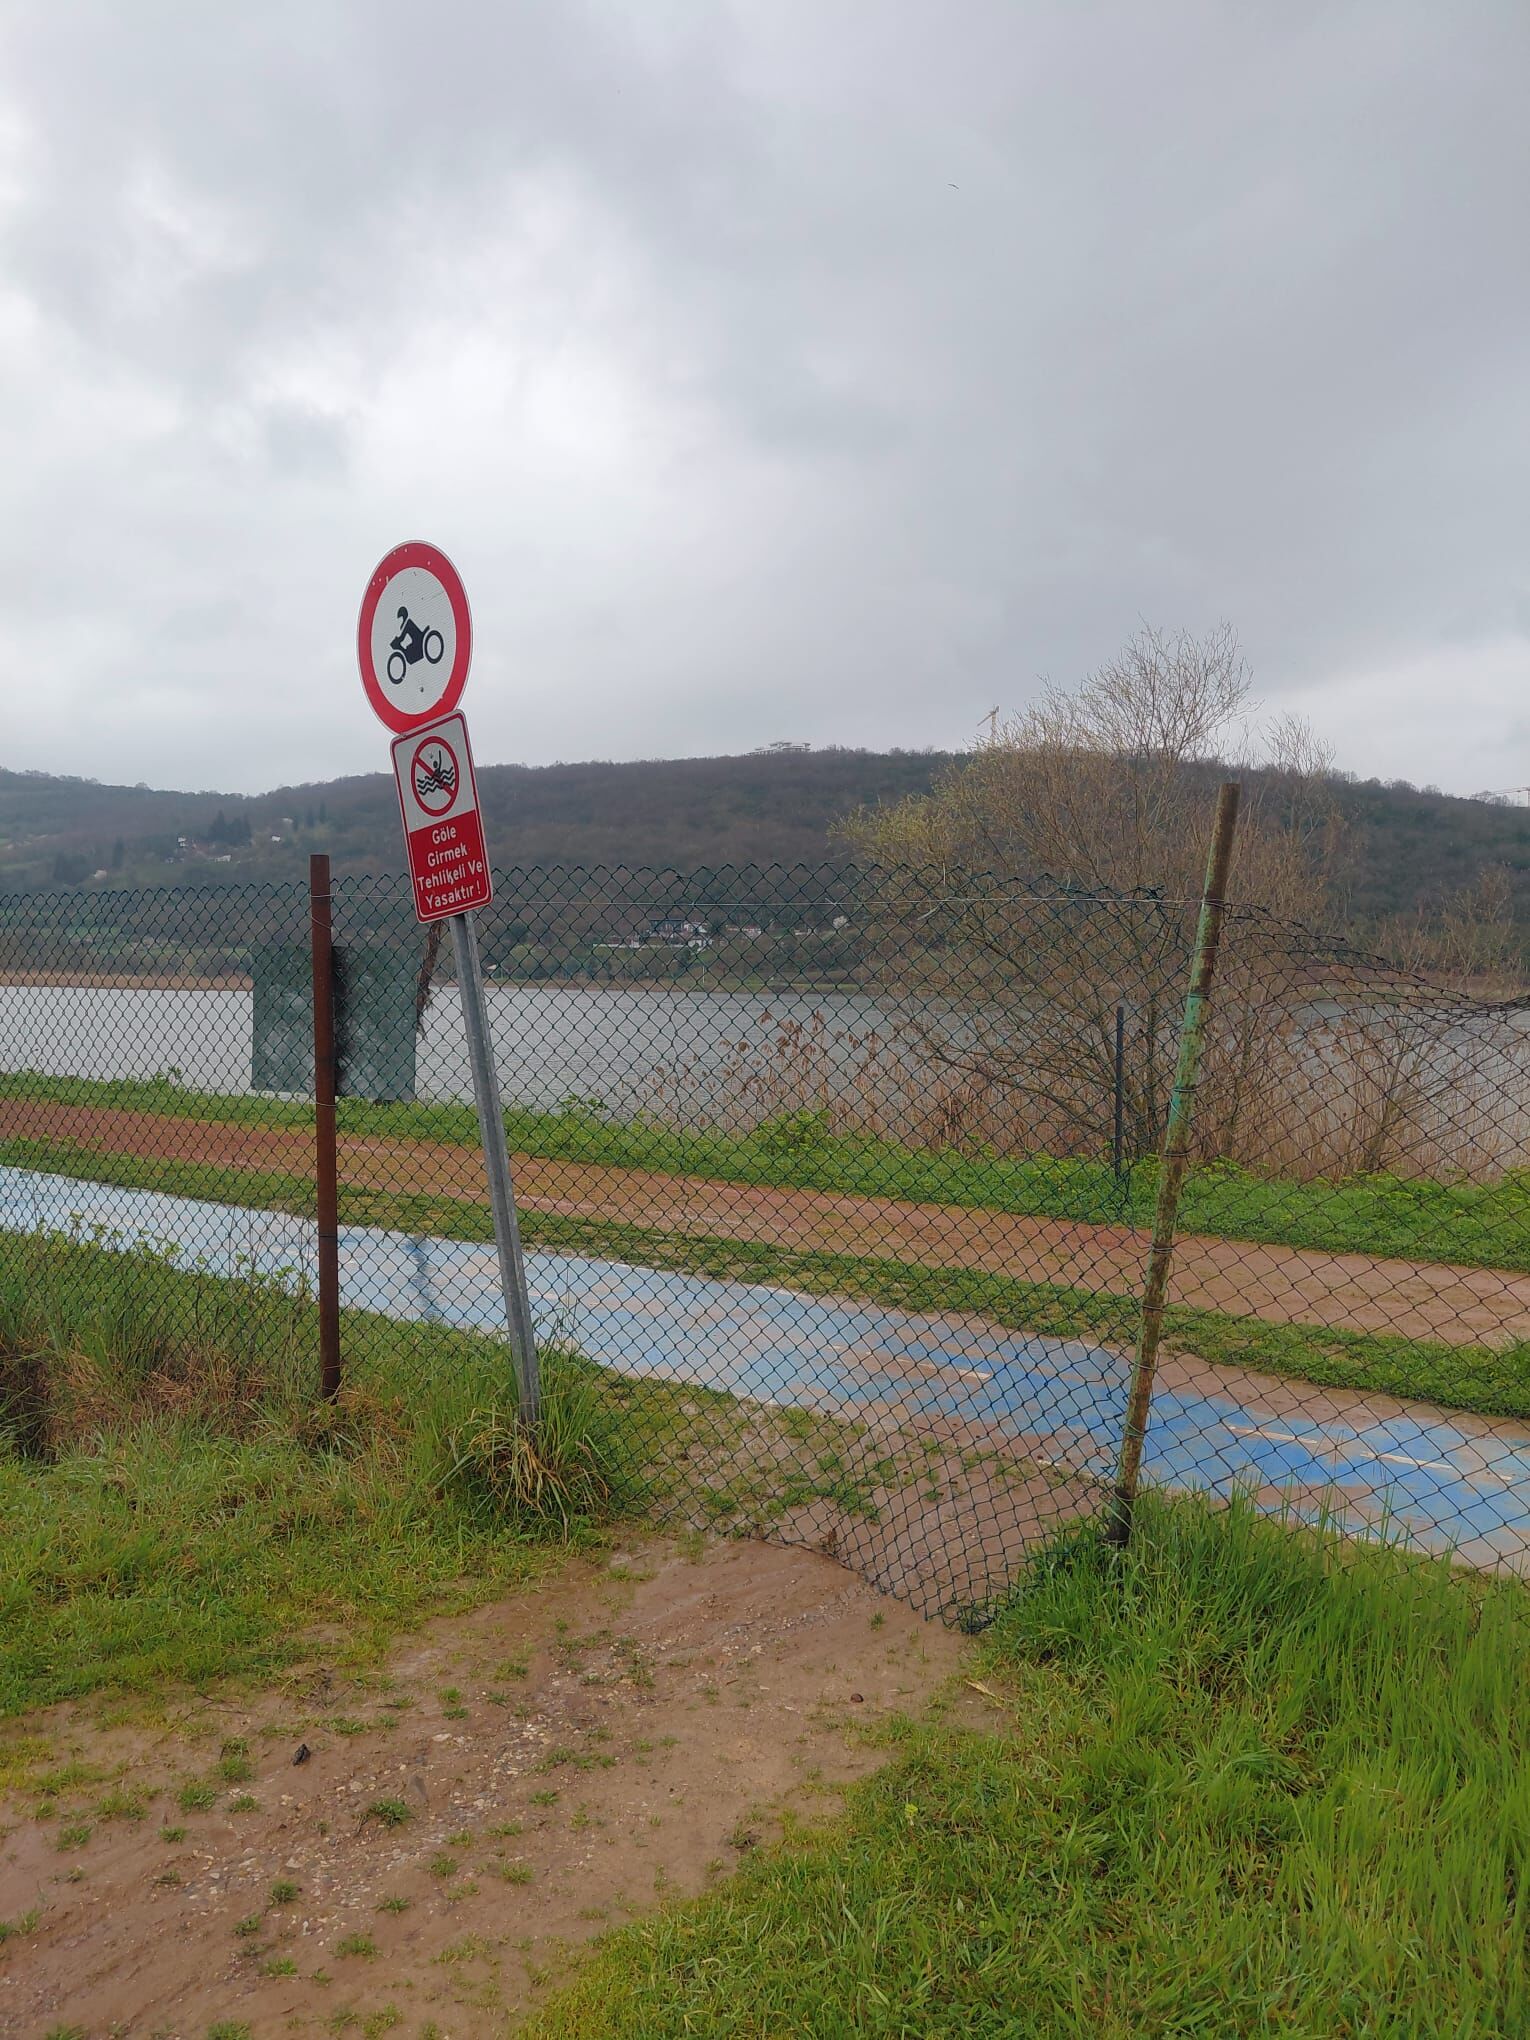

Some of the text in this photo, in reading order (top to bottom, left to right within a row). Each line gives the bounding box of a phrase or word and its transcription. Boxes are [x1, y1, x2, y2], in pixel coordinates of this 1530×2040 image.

[432, 826, 457, 844] Göle
[427, 842, 468, 867] Girmek
[468, 860, 483, 875] Ve
[425, 884, 474, 909] Yasaktır
